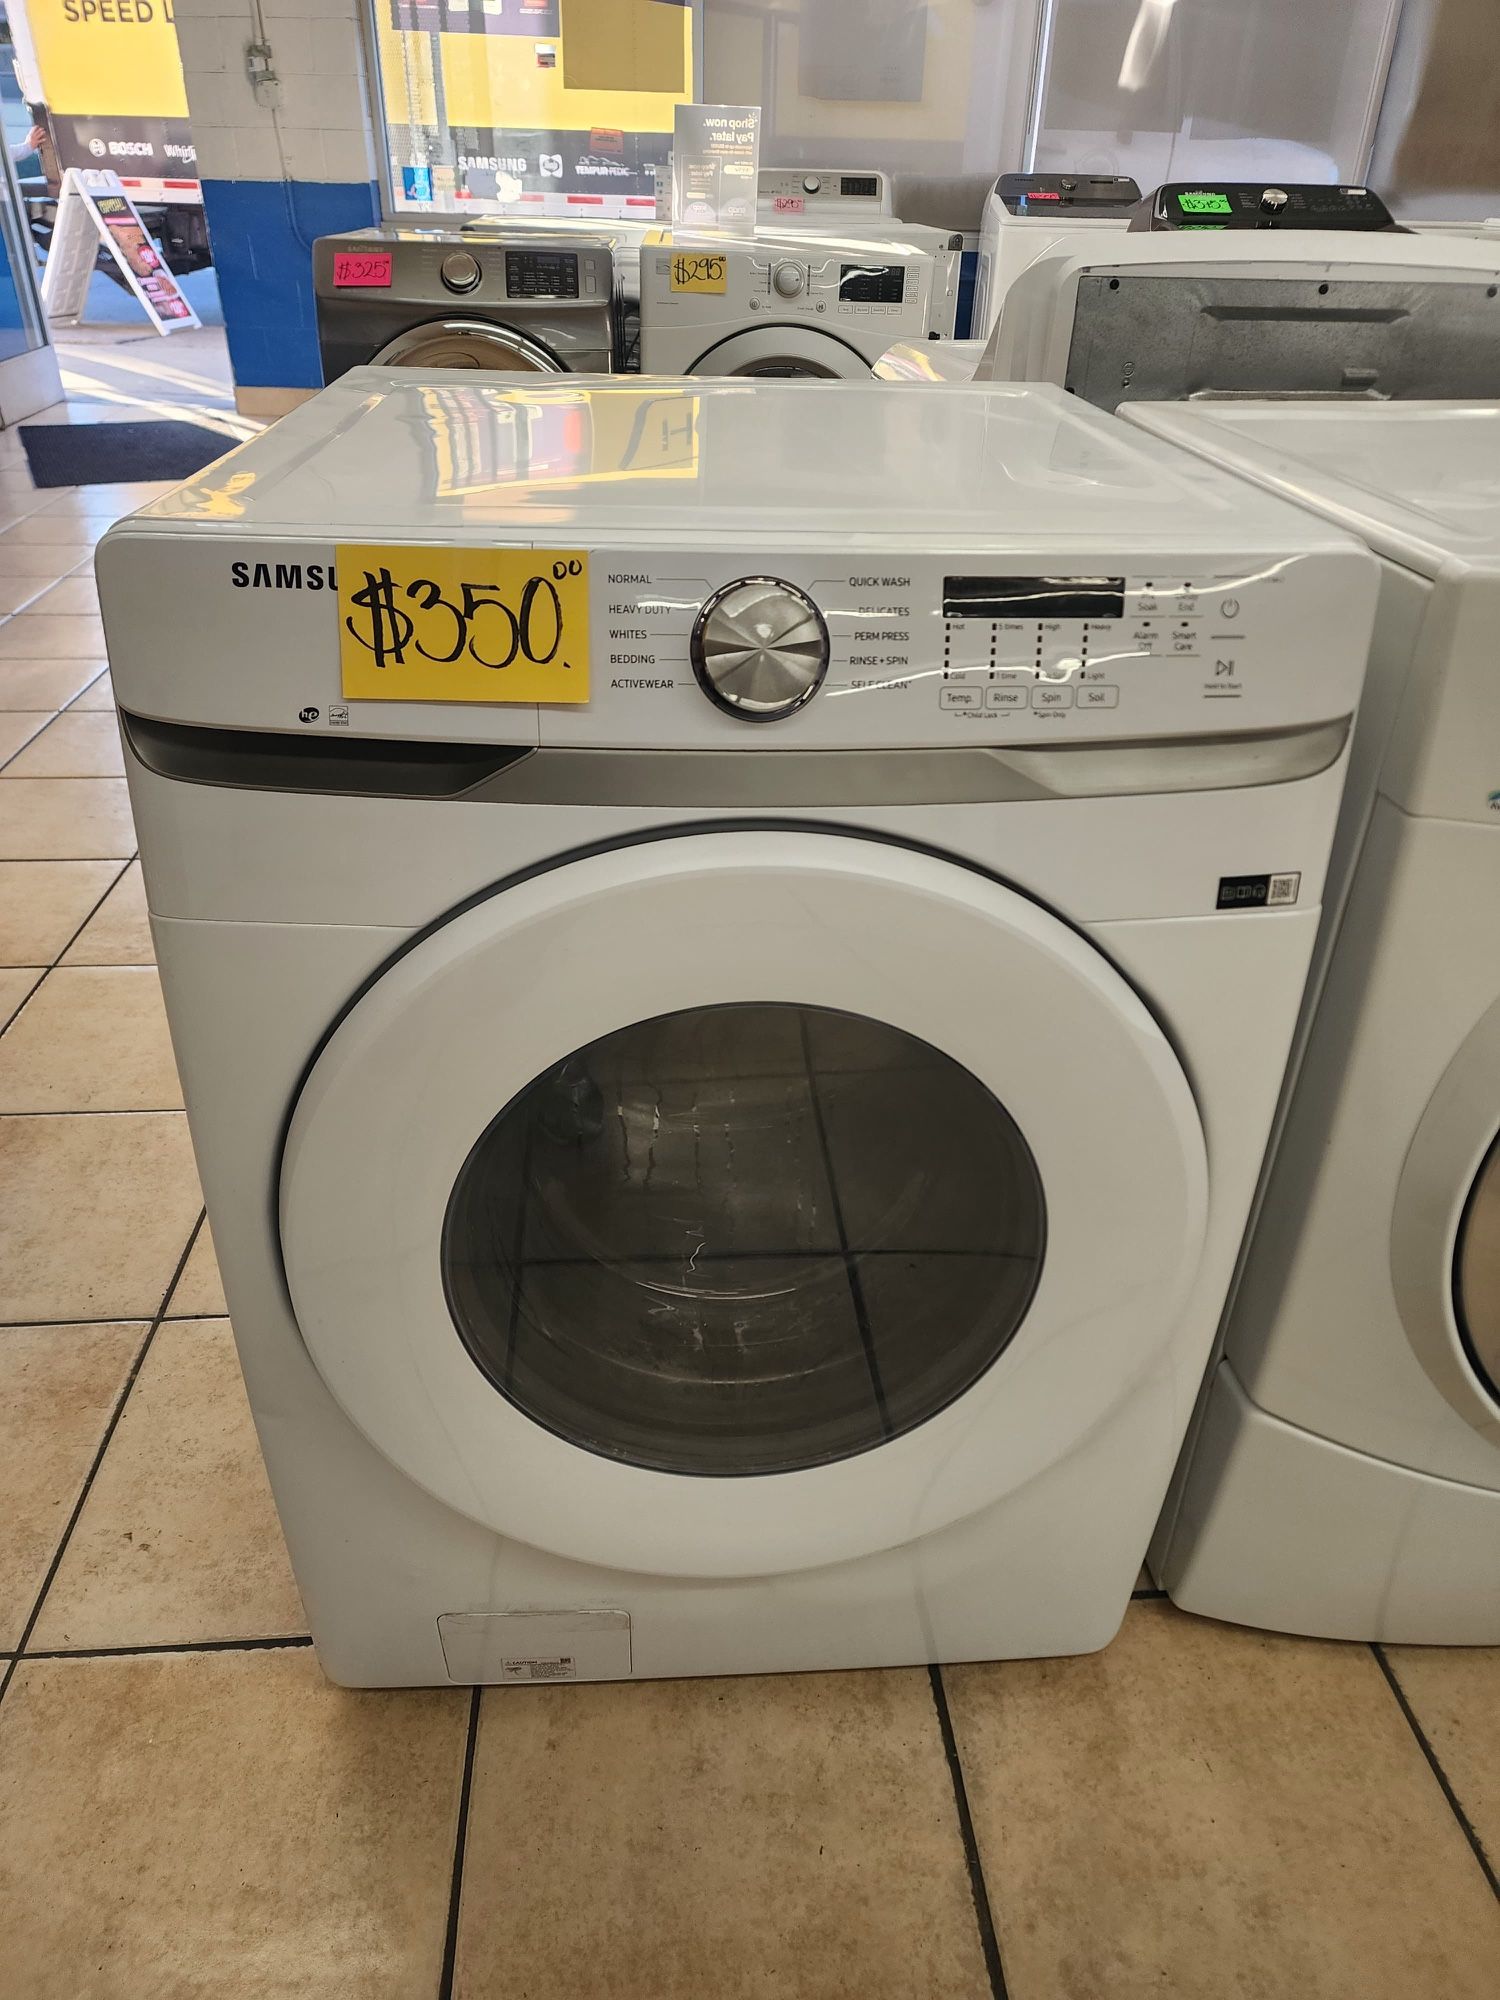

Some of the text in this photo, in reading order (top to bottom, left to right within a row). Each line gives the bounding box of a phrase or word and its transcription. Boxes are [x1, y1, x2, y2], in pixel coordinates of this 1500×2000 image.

[64, 0, 154, 22] SPEED
[108, 141, 154, 156] BOSCH
[457, 155, 527, 173] SAMSUNG
[608, 574, 652, 584] NORMAL
[849, 577, 911, 587] QUICK WASH
[608, 604, 672, 614] HEAVY DUTY
[609, 629, 647, 639] WHITES
[854, 631, 910, 641] PERM PRESS
[610, 654, 656, 664] BEDDING
[849, 656, 878, 665] RINSE
[886, 656, 908, 665] SPIN
[611, 679, 674, 689] ACTIVEWEAR
[993, 693, 1019, 702] Rinse
[1042, 692, 1061, 704] Spin
[1088, 692, 1105, 702] Soil
